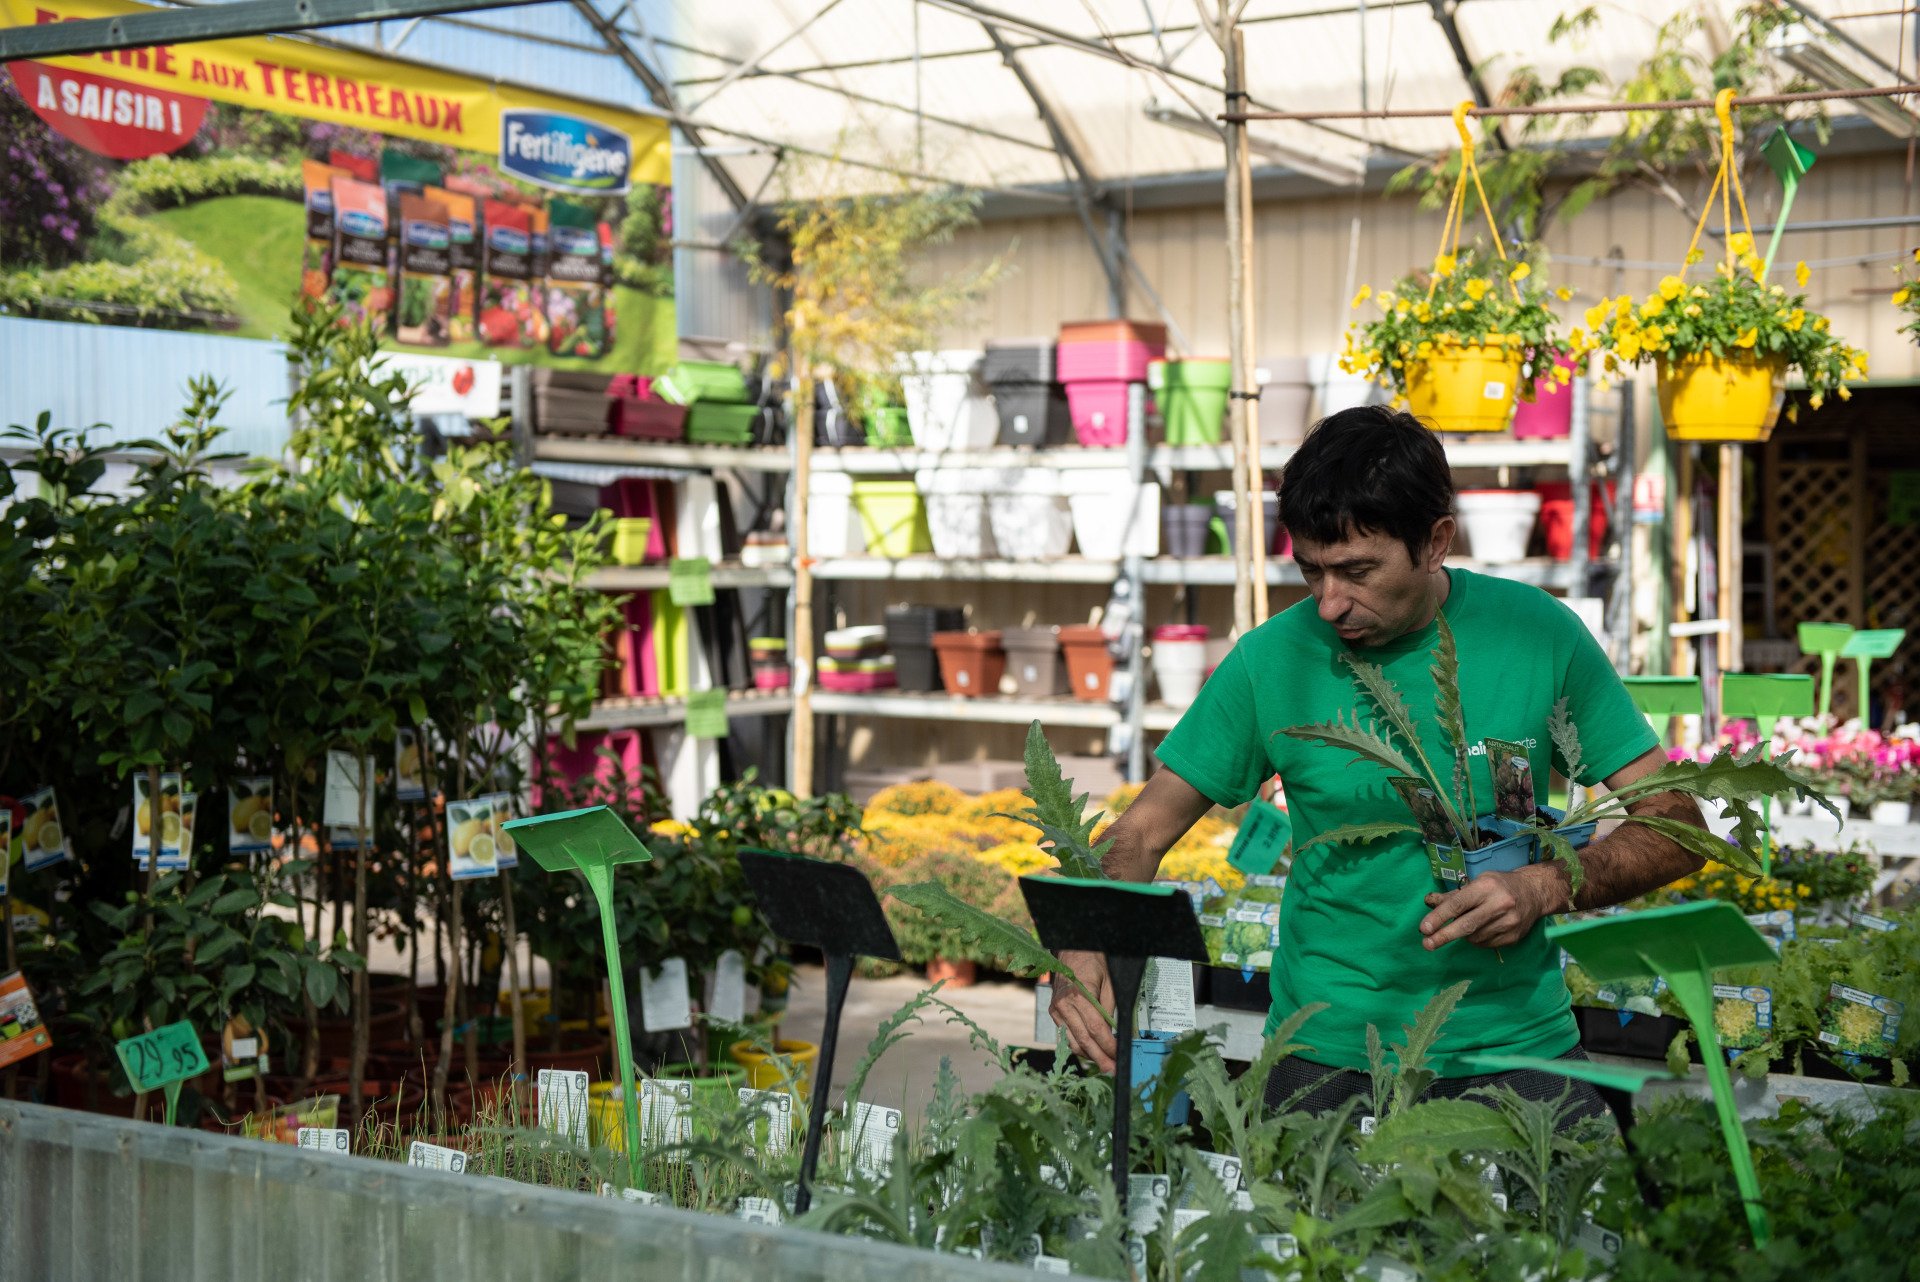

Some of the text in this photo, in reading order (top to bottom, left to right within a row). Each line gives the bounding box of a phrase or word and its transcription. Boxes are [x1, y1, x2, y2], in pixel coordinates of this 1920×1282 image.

[37, 74, 57, 111] A
[60, 79, 165, 132] SAISIR
[191, 58, 249, 92] AUX
[254, 60, 463, 134] TERREAUX
